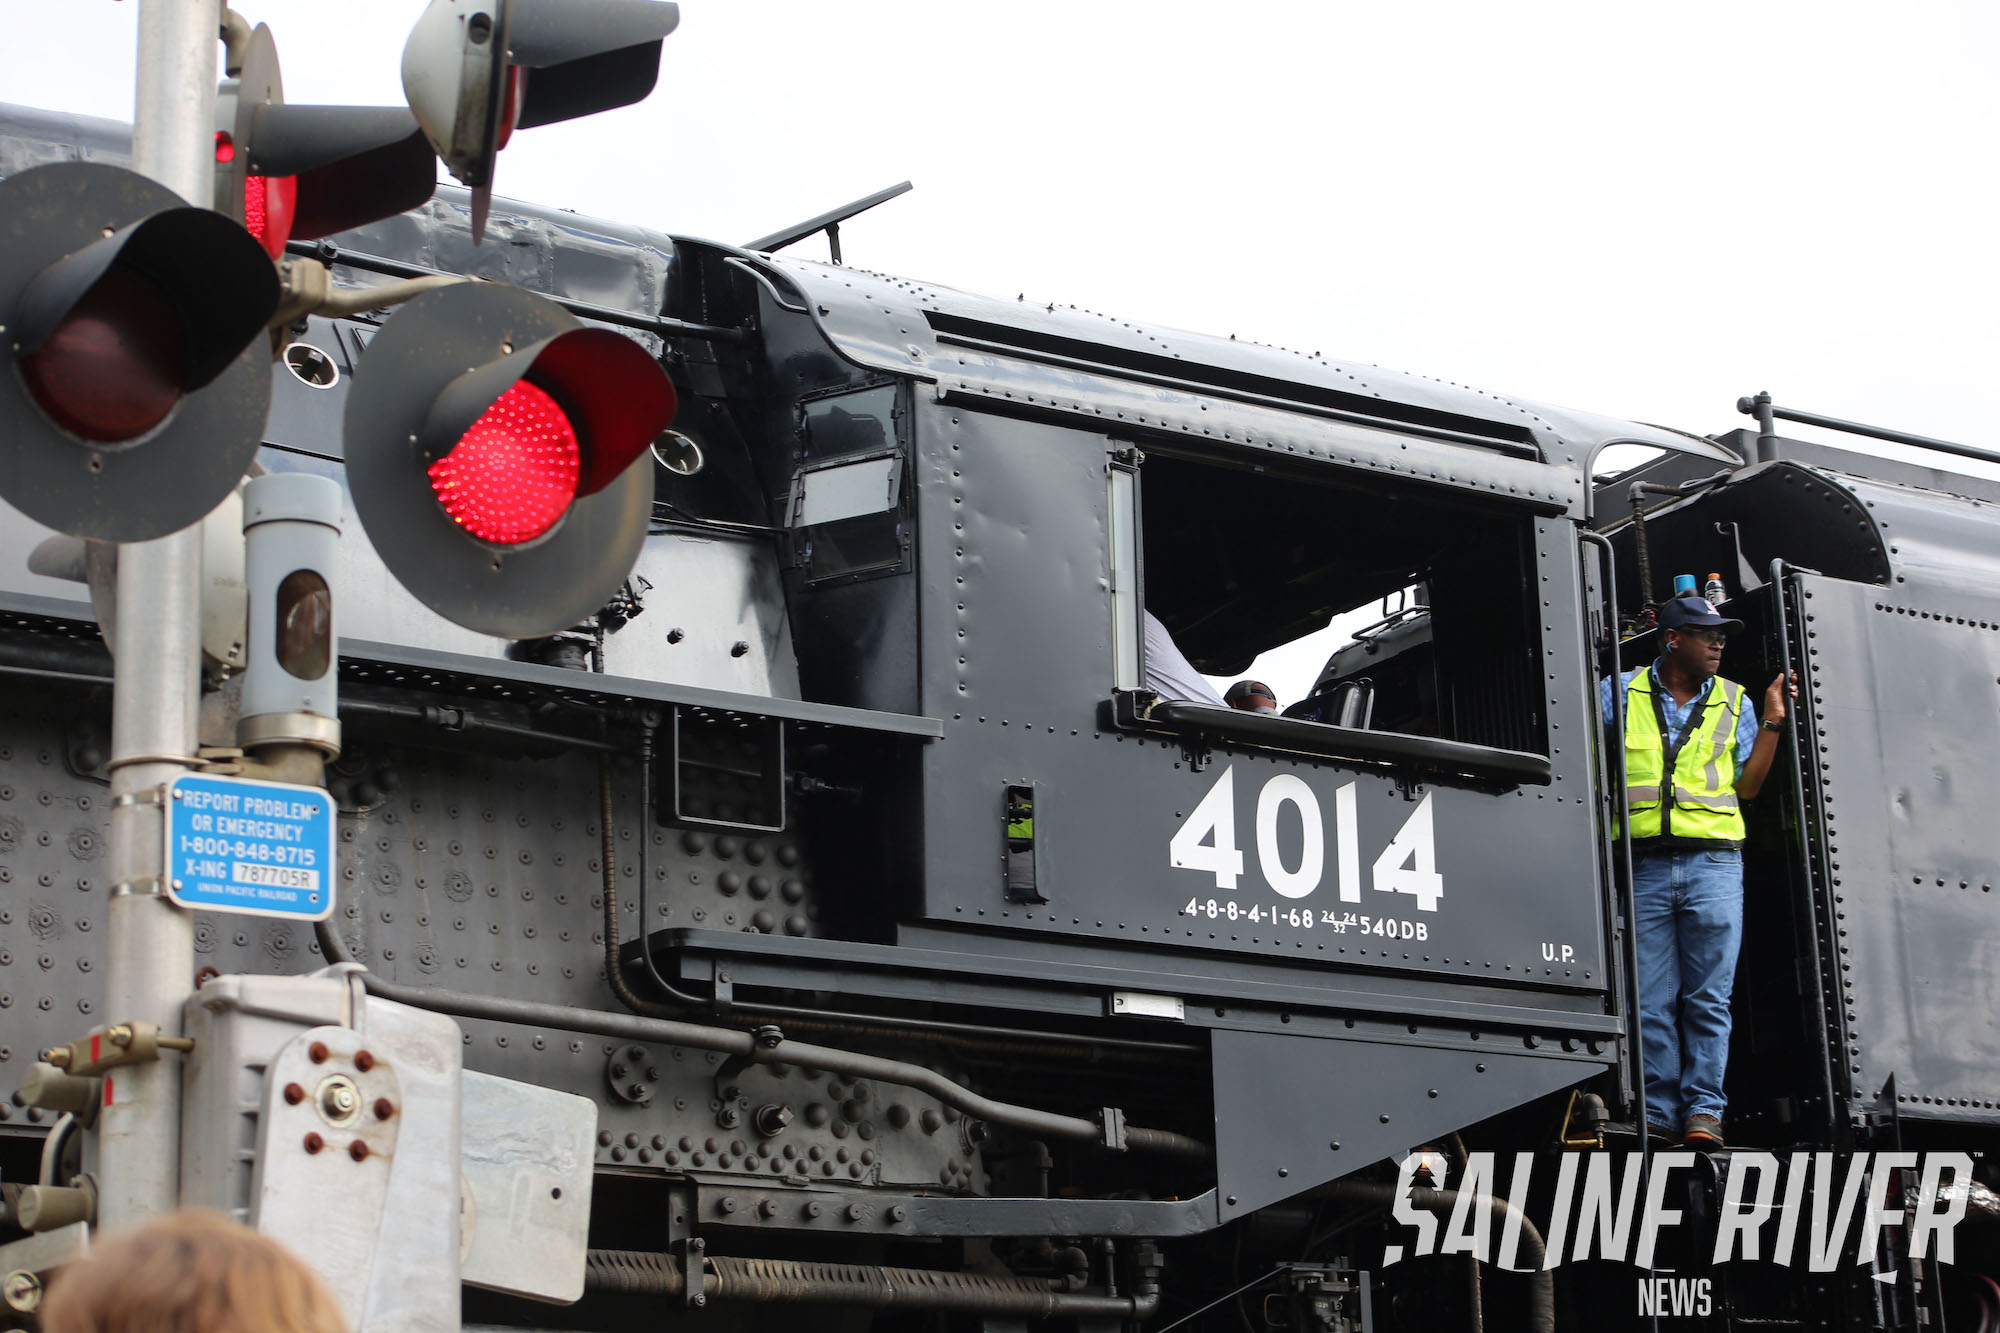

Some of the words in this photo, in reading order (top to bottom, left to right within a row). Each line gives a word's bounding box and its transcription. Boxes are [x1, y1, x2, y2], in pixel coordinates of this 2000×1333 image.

[183, 790, 240, 813] REPORT
[244, 797, 312, 821] PROBLEM
[192, 813, 213, 832] OR
[217, 816, 303, 841] EMERGENCY
[1170, 764, 1444, 912] 4014
[180, 835, 316, 866] 1-800-848-8715
[185, 858, 227, 879] X-ING
[240, 864, 312, 888] 787705R
[197, 882, 223, 895] UNION
[225, 885, 257, 898] PACIFIC
[258, 888, 298, 902] RAILROAD
[1542, 942, 1575, 963] U.P.
